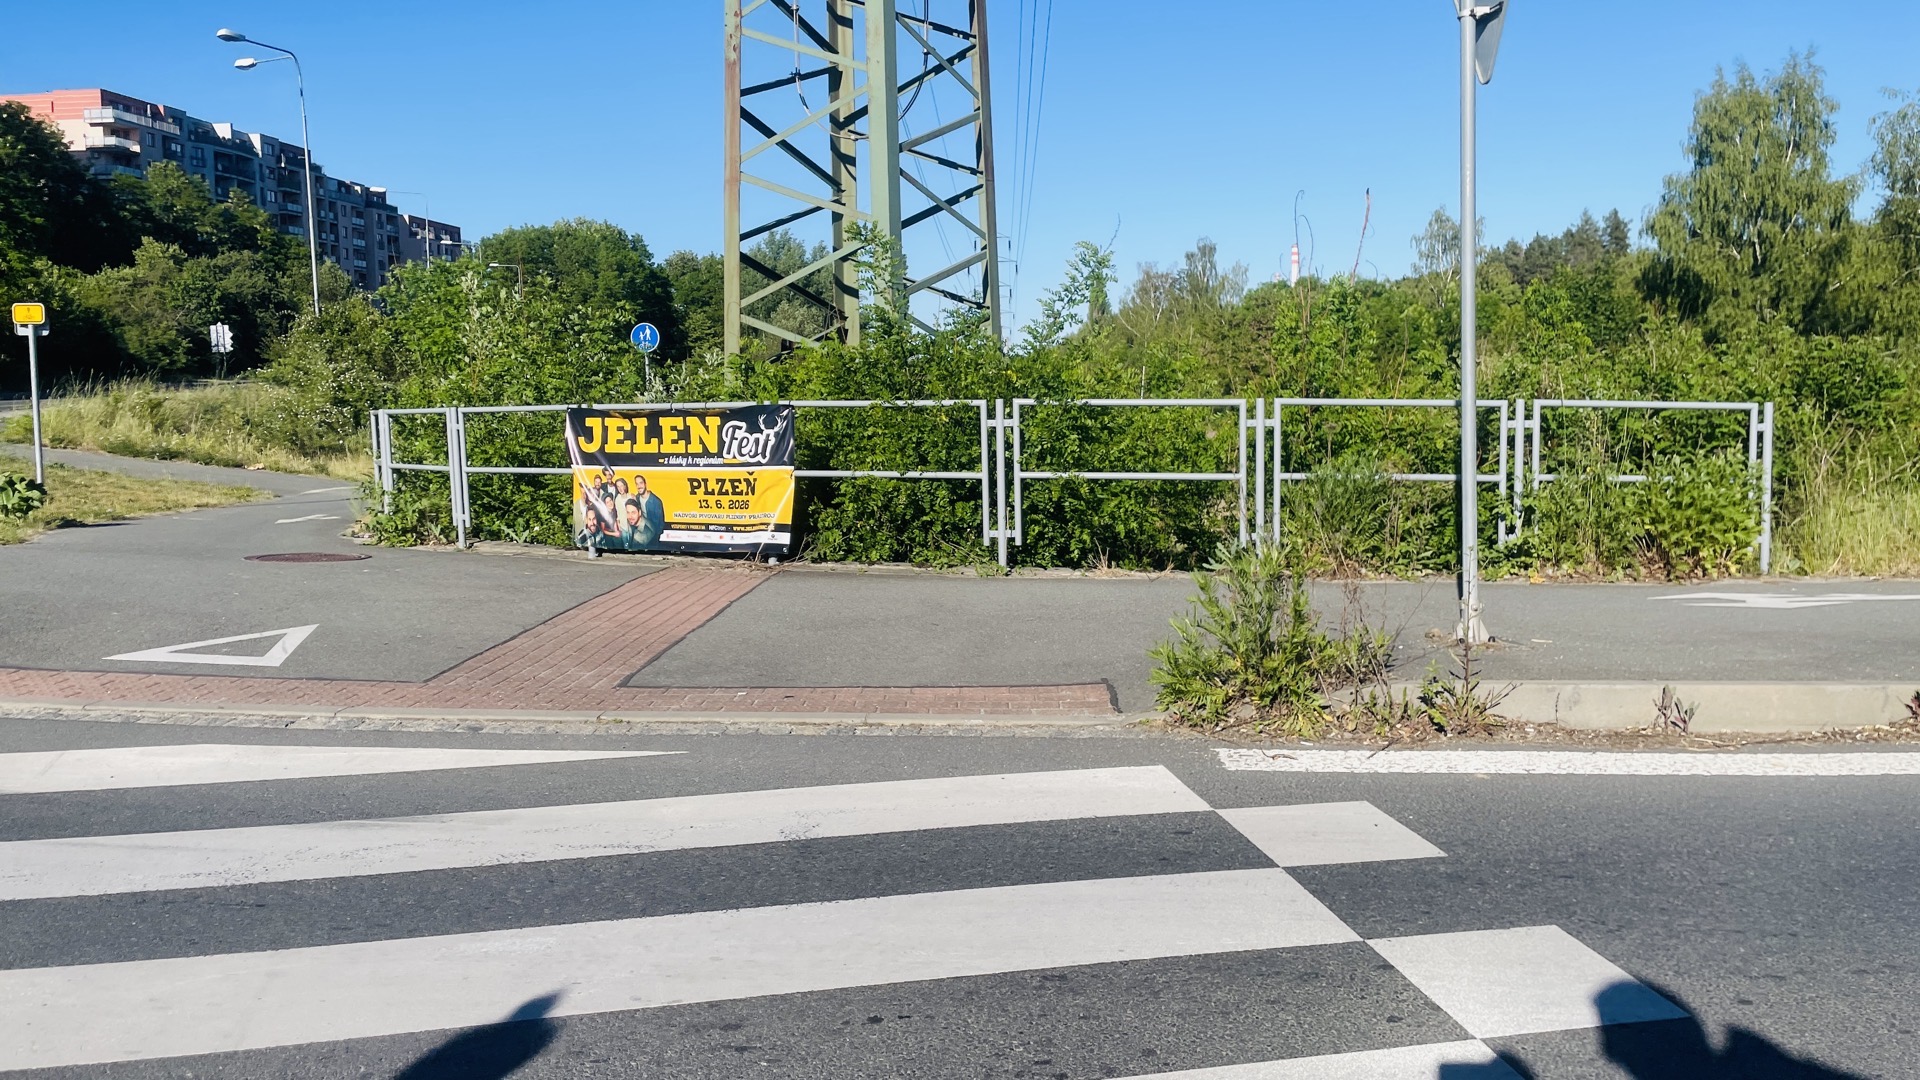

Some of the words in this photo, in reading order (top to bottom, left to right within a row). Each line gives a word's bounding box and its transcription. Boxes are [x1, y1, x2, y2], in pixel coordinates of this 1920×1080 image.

[578, 416, 721, 453] JELEN
[722, 421, 775, 463] Fest
[669, 456, 687, 466] lásky
[688, 456, 692, 464] k
[687, 471, 758, 496] PLZEŇ
[698, 500, 712, 509] 13.
[715, 500, 724, 510] 6.
[728, 500, 750, 510] 2026
